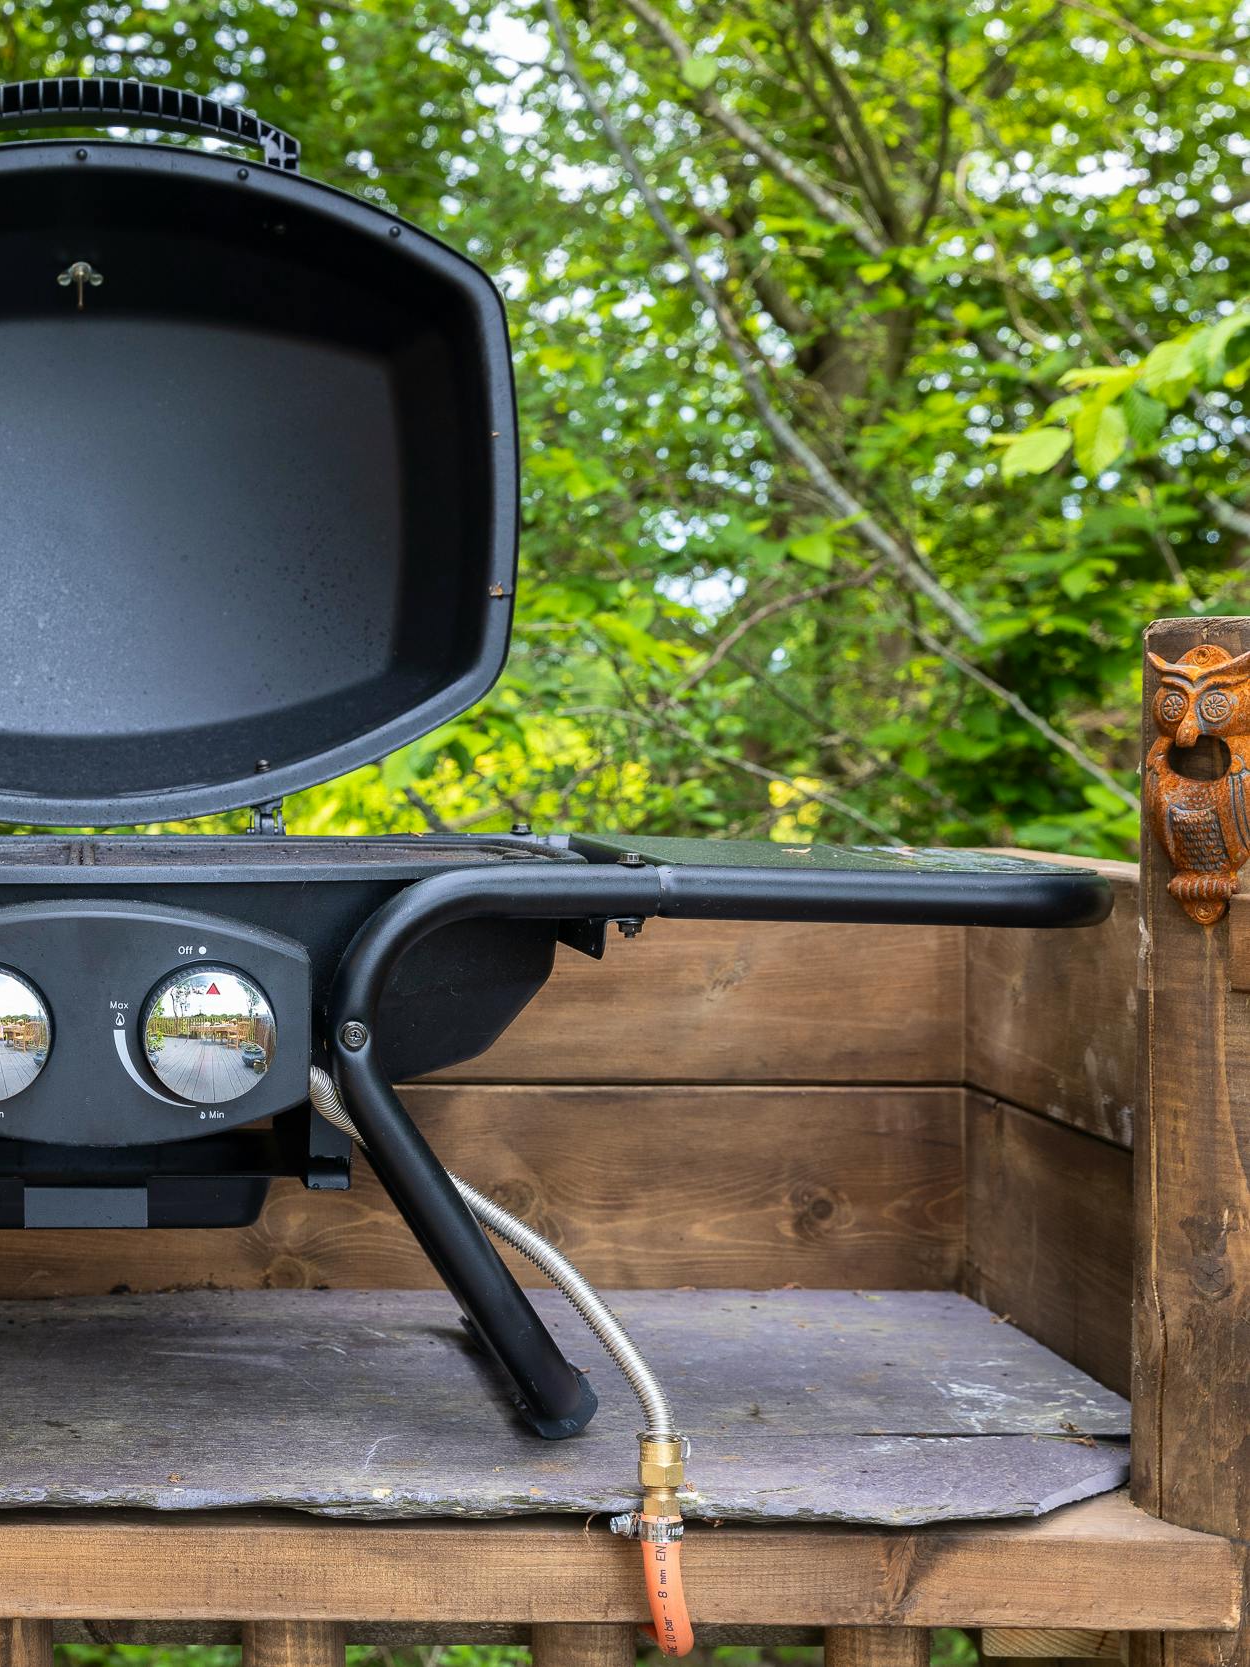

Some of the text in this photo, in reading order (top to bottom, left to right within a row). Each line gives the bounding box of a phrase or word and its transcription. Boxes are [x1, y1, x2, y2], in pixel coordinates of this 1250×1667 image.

[177, 945, 193, 955] Off
[109, 1000, 129, 1010] Max
[209, 1110, 225, 1119] Min
[660, 1569, 667, 1585] mm
[657, 1590, 668, 1598] 8
[663, 1617, 674, 1632] bar
[664, 1634, 677, 1643] 10
